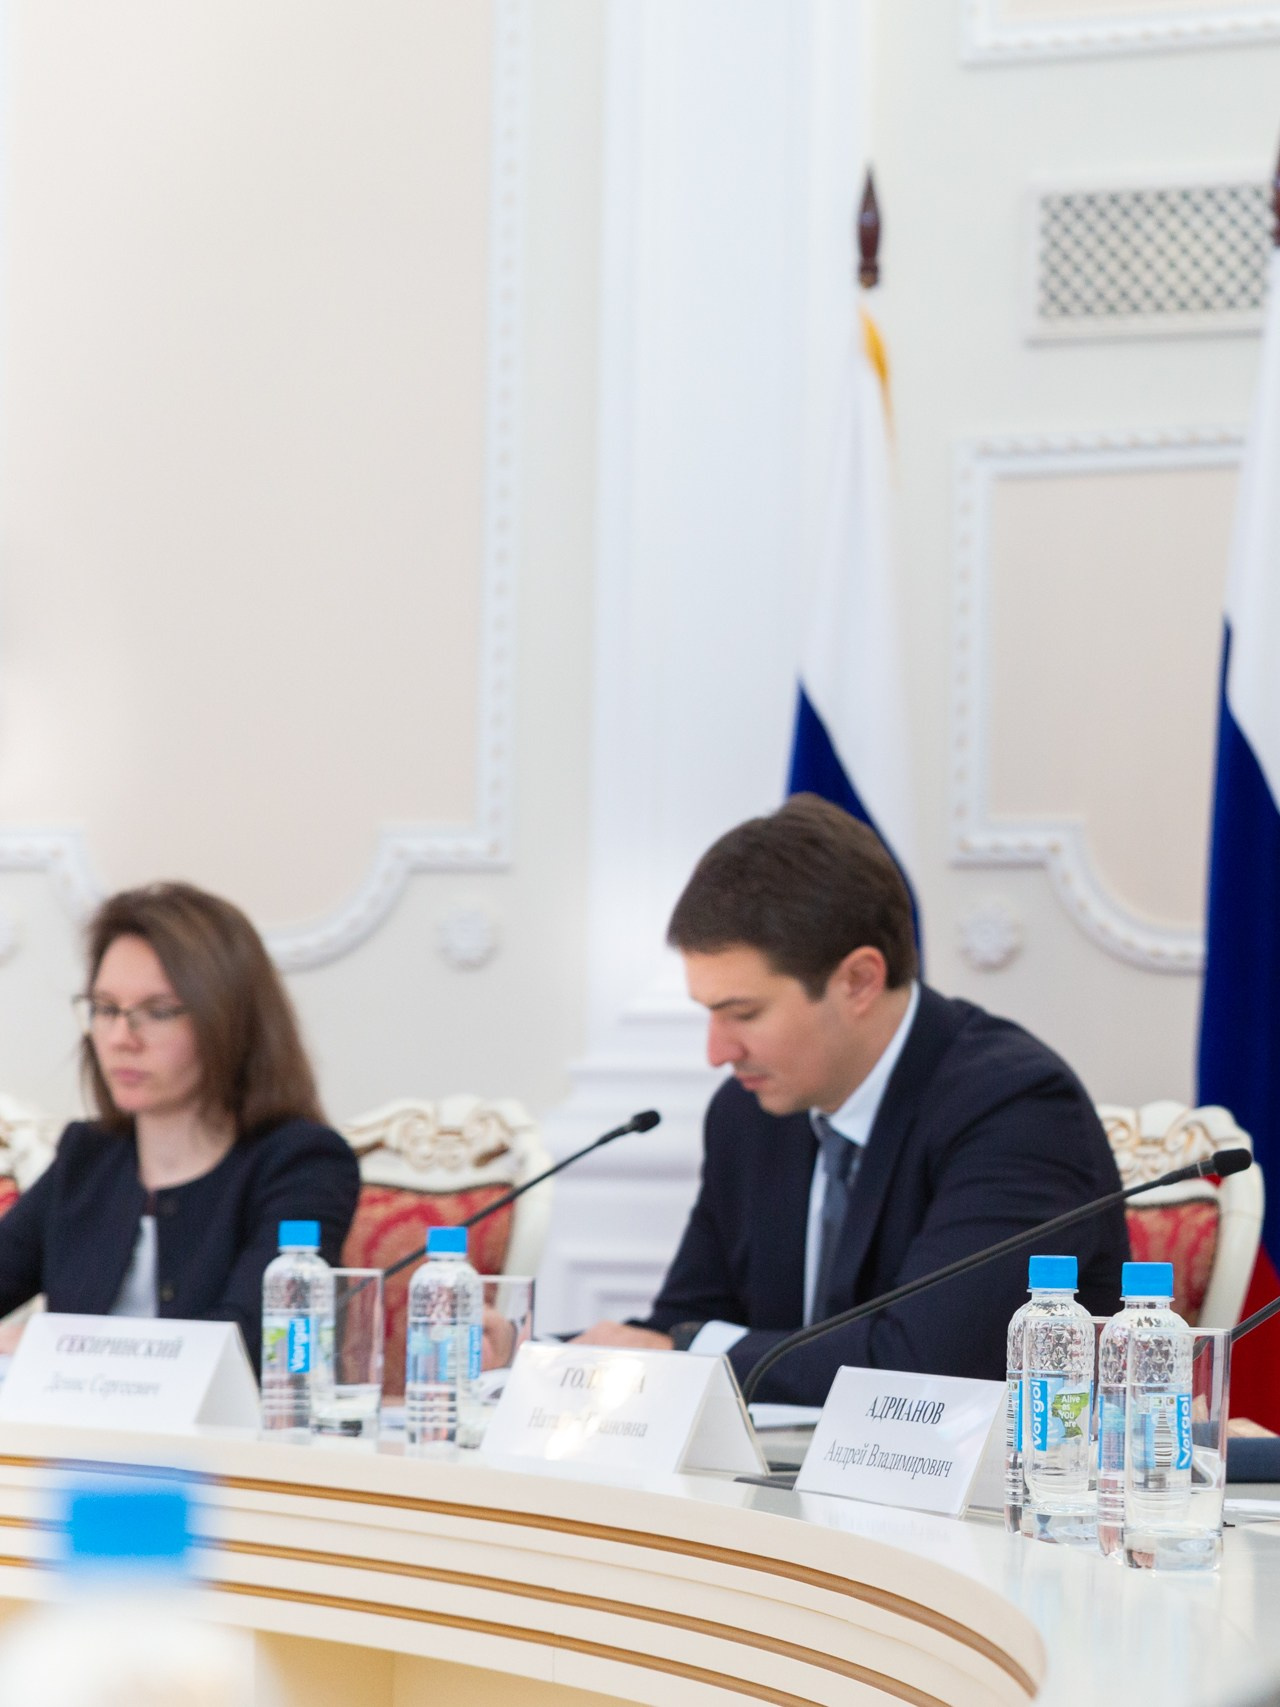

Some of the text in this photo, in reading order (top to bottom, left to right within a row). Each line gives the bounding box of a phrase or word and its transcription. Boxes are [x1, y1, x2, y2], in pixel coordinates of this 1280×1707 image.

[865, 1395, 946, 1425] АДРИАНОВ
[1061, 1394, 1081, 1403] Alive
[823, 1439, 953, 1480] Андрей Владимирович
